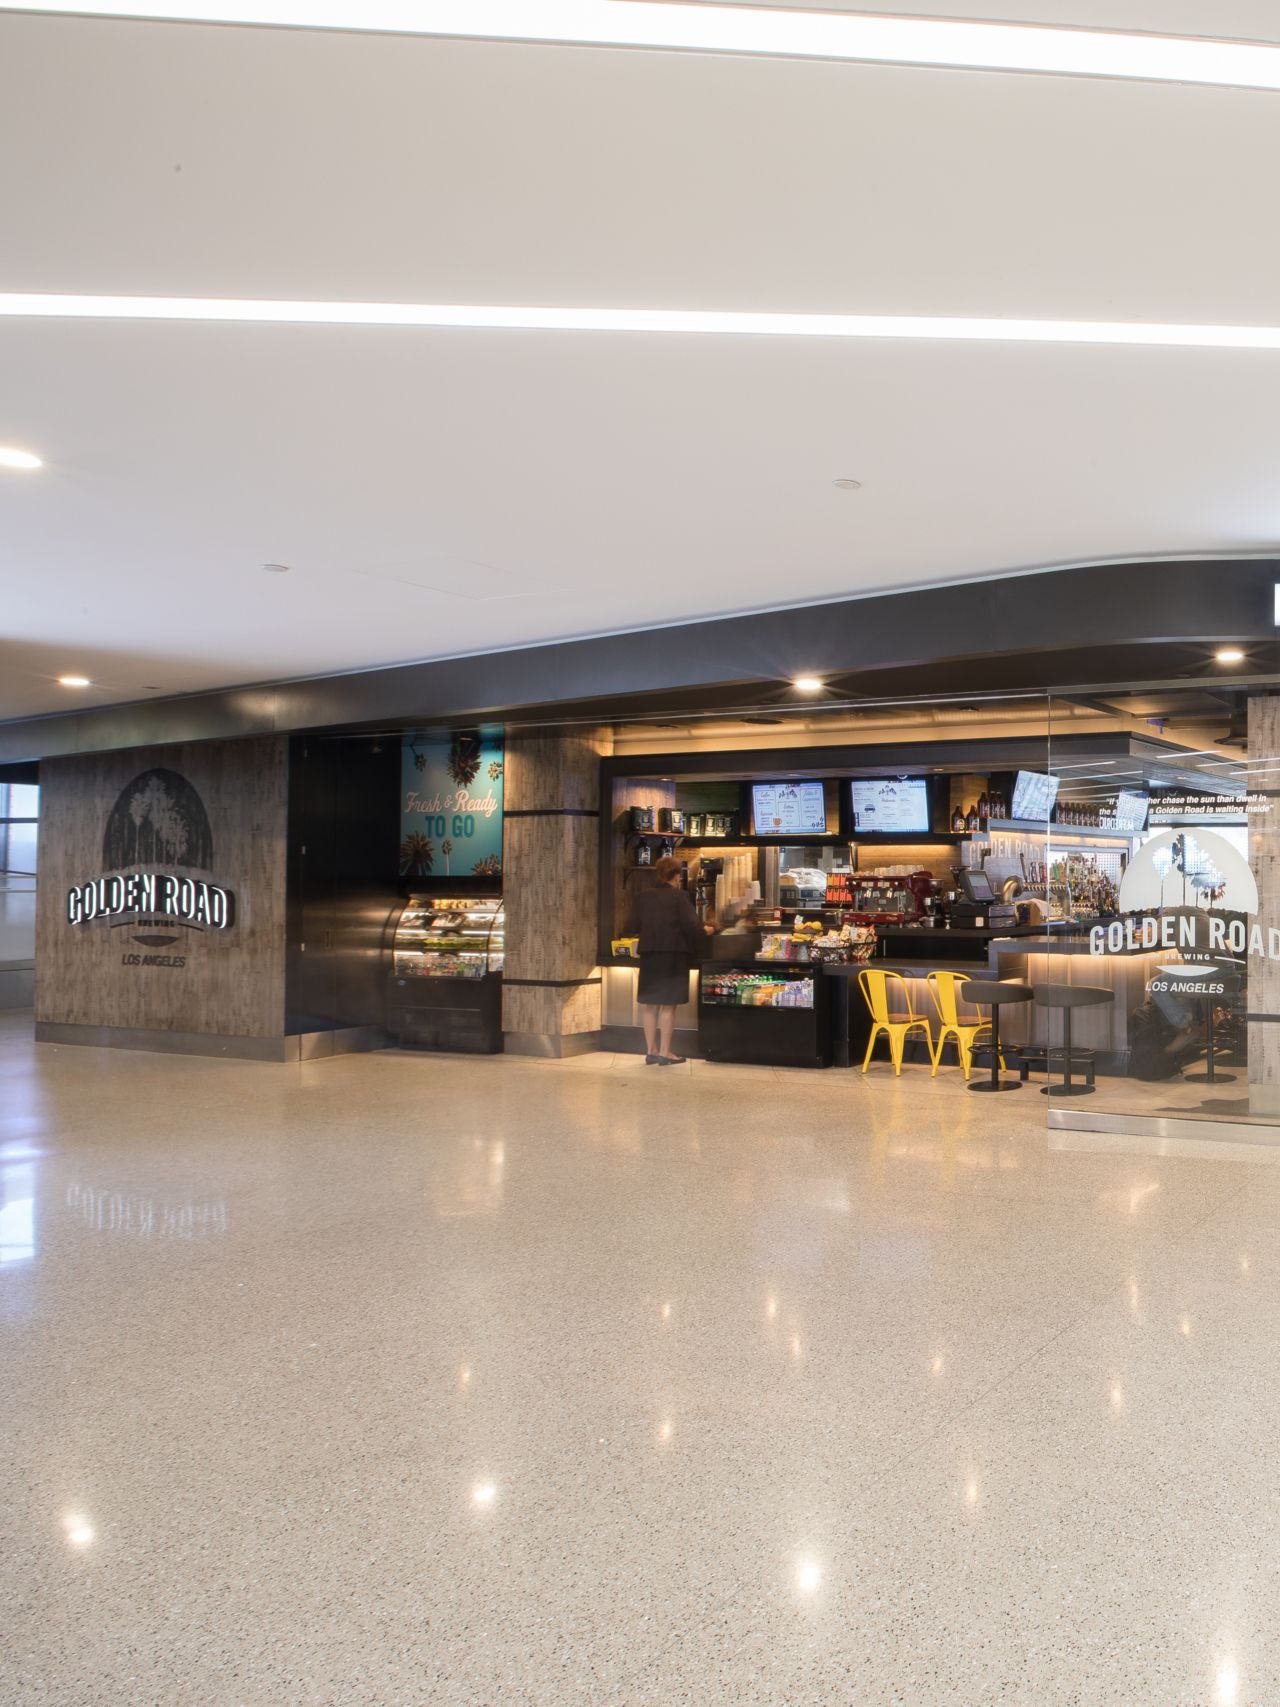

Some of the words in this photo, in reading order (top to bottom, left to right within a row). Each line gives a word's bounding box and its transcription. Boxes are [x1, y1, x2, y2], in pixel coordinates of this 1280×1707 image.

[404, 791, 442, 812] Fresh
[443, 795, 453, 808] &
[452, 789, 498, 818] Ready
[1161, 797, 1185, 805] chase
[1186, 796, 1199, 804] the
[1217, 795, 1235, 803] than
[1235, 794, 1257, 803] dwell
[1258, 794, 1267, 802] in
[1155, 806, 1183, 814] Golden
[1184, 805, 1206, 813] Road
[1206, 805, 1214, 813] is
[1215, 804, 1243, 815] waiting
[425, 815, 446, 839] TO
[452, 815, 475, 838] GO
[68, 873, 158, 925] GOLDEN
[160, 875, 235, 929] ROAD
[1089, 916, 1196, 956] GOLDEN
[122, 954, 140, 966] LOS
[141, 955, 186, 968] ANGELES
[1145, 981, 1169, 992] LOS
[1170, 982, 1225, 994] ANGELES
